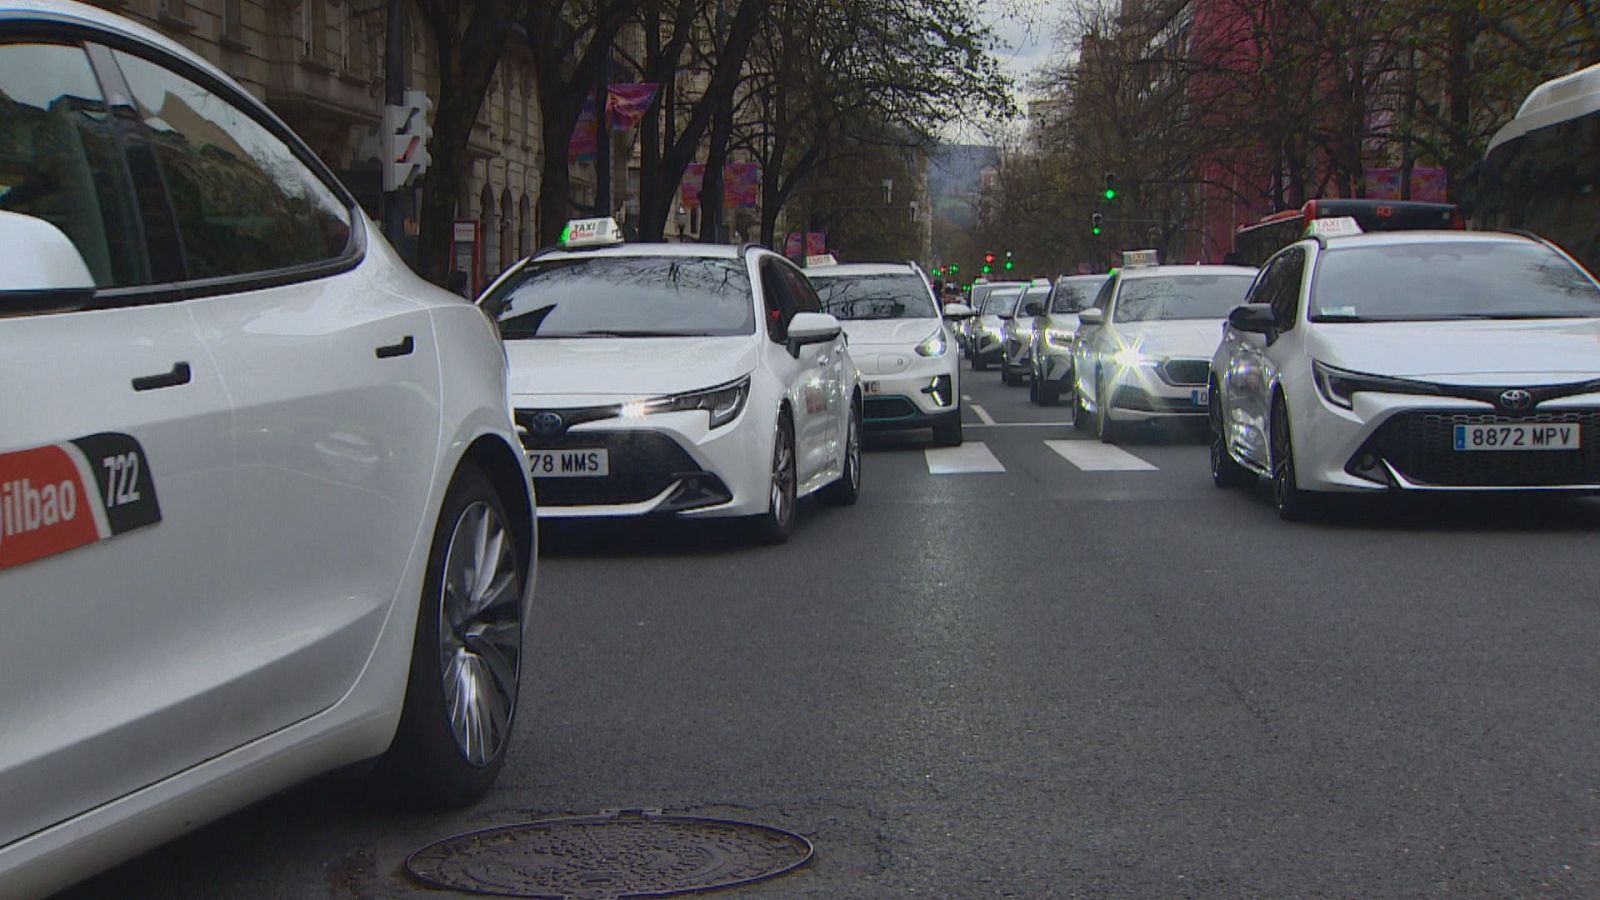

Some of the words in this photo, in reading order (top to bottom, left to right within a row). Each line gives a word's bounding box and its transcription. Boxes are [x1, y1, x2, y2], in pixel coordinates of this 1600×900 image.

[575, 222, 596, 232] TAXI
[1316, 219, 1339, 228] TAXI
[863, 381, 878, 392] WC
[1473, 428, 1525, 446] 8872
[1532, 427, 1570, 445] MPV
[529, 454, 554, 473] 78
[561, 453, 599, 472] MMS
[103, 451, 141, 508] 722
[0, 477, 77, 536] ilbao
